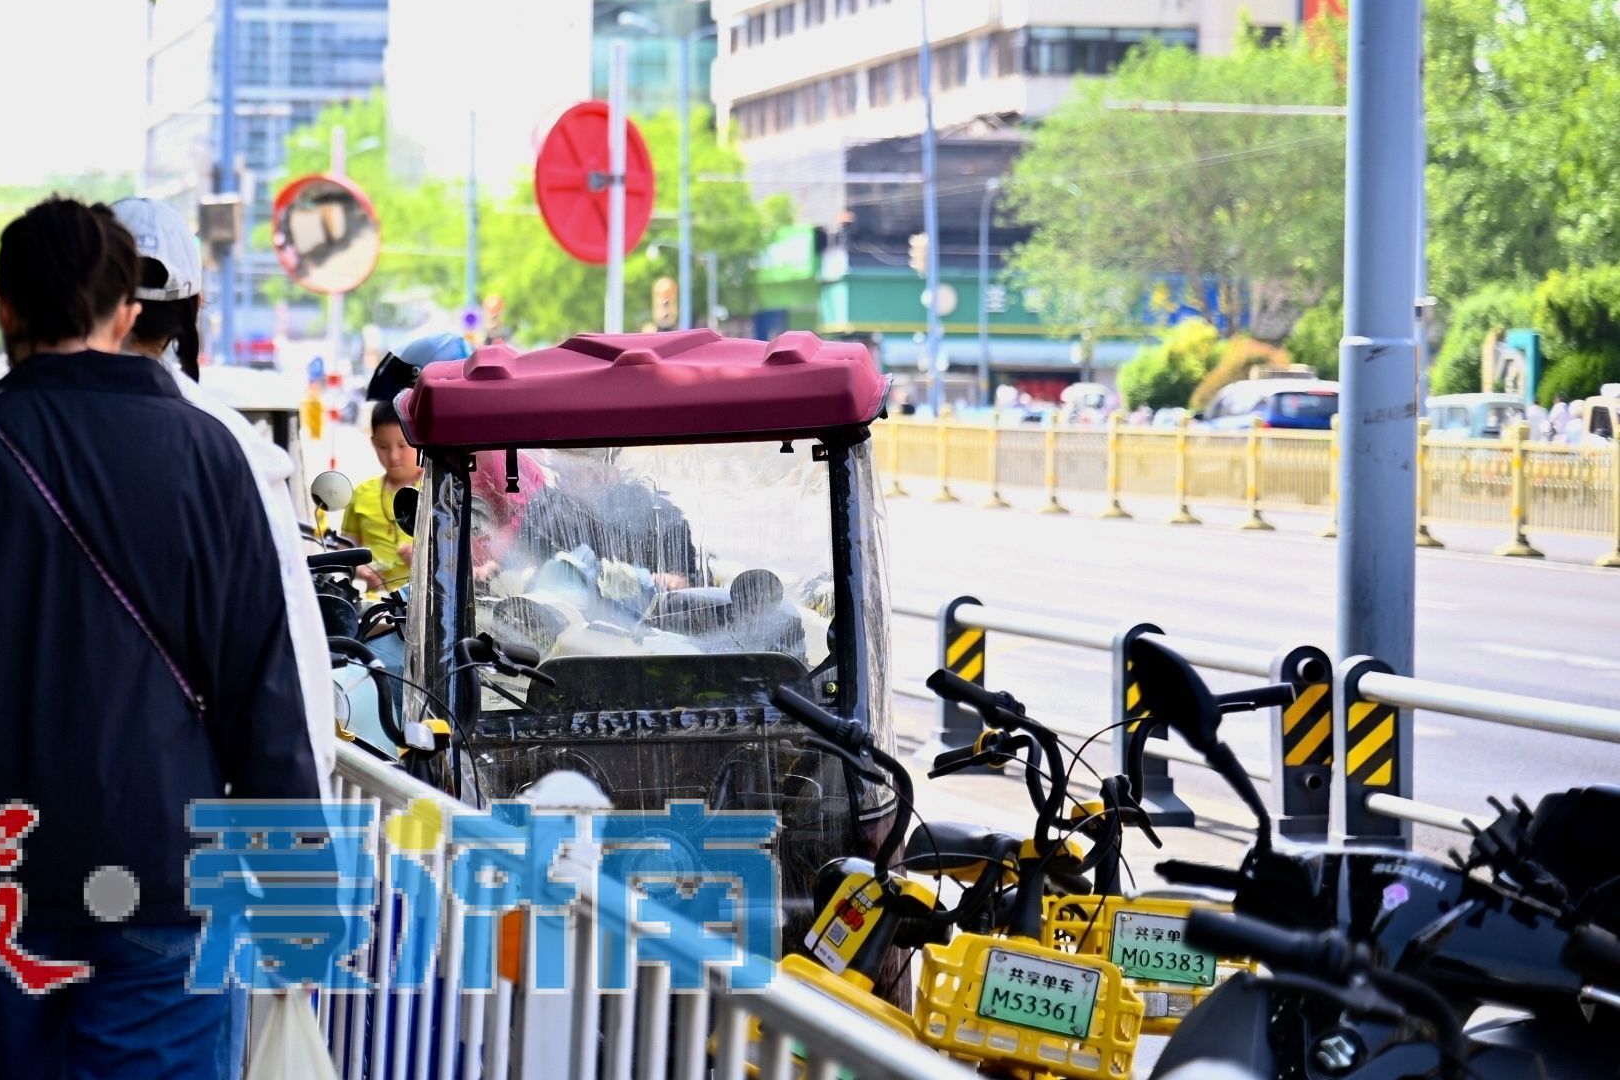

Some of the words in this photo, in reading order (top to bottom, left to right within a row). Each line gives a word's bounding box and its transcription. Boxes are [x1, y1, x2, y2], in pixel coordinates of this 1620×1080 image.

[1372, 862, 1447, 892] SUZUKI
[1135, 926, 1182, 944] 共享单
[1121, 946, 1205, 973] M05383
[1009, 967, 1075, 994] 共享单车
[991, 986, 1077, 1023] M53361
